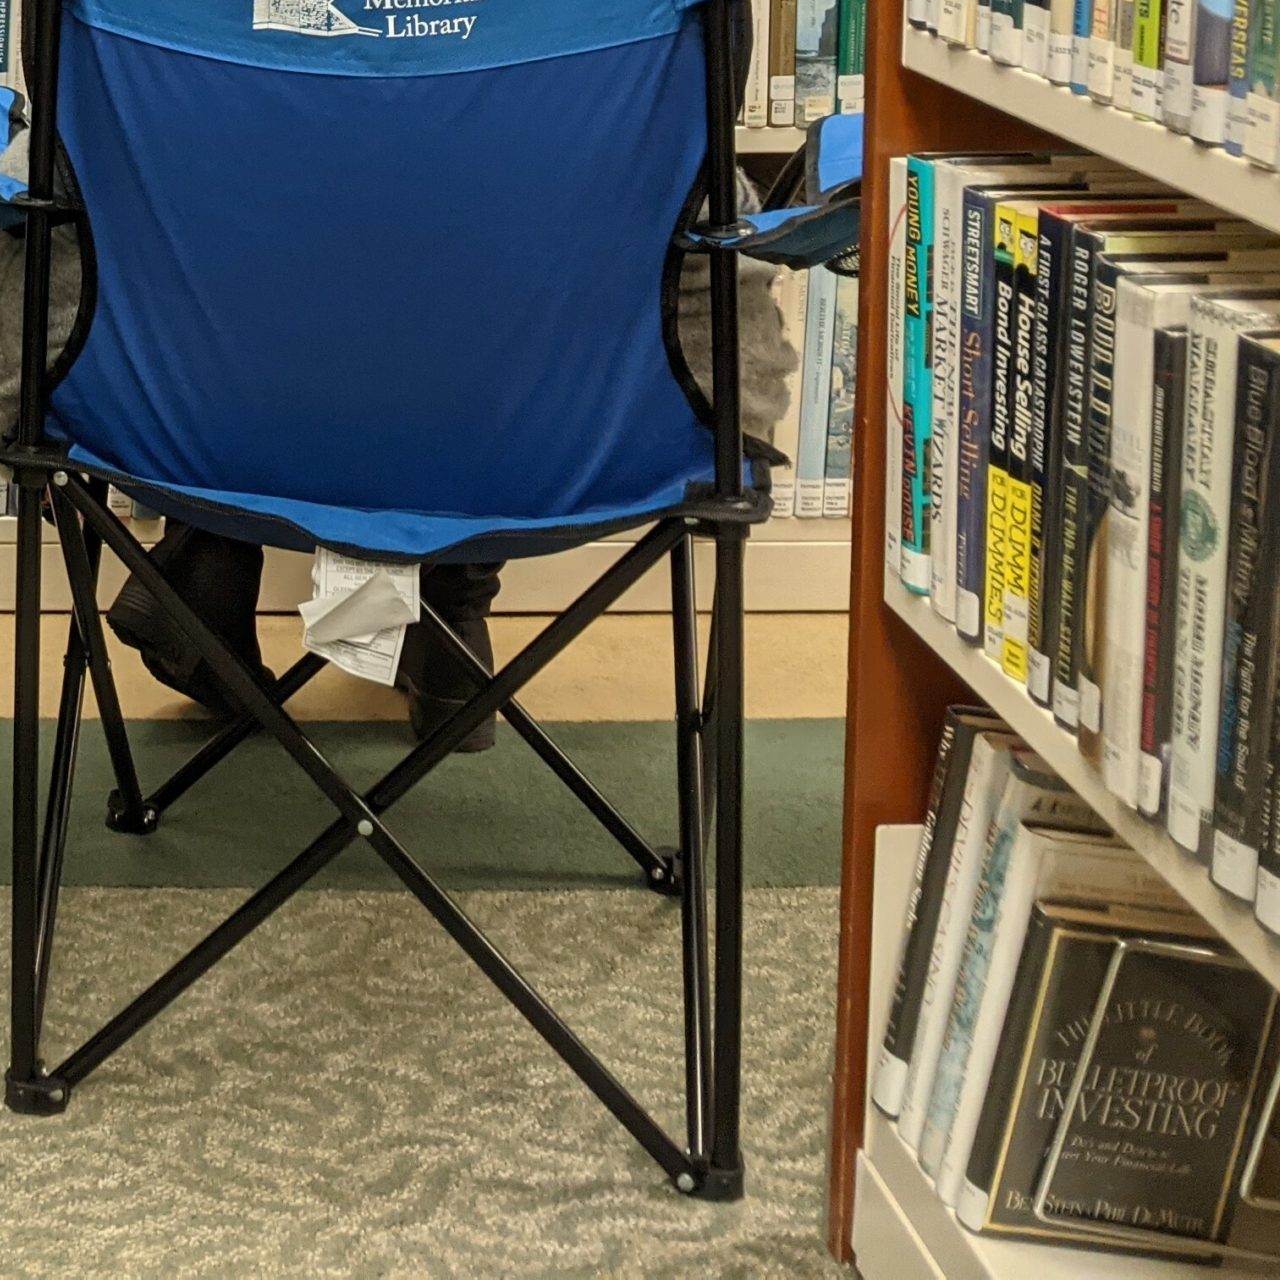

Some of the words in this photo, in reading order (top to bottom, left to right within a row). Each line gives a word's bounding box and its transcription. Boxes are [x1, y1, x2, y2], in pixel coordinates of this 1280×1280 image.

[385, 15, 477, 39] Library
[965, 210, 981, 314] STREETSMART
[1072, 246, 1090, 309] ROGER
[997, 280, 1011, 342] Bond
[1016, 292, 1035, 369] House
[962, 332, 980, 402] Short
[991, 346, 1010, 451] Investing
[1065, 317, 1085, 446] LOWENSTEIN
[959, 408, 978, 500] Selling
[1010, 375, 1032, 461] Selling
[987, 485, 1007, 619] DUMMIES
